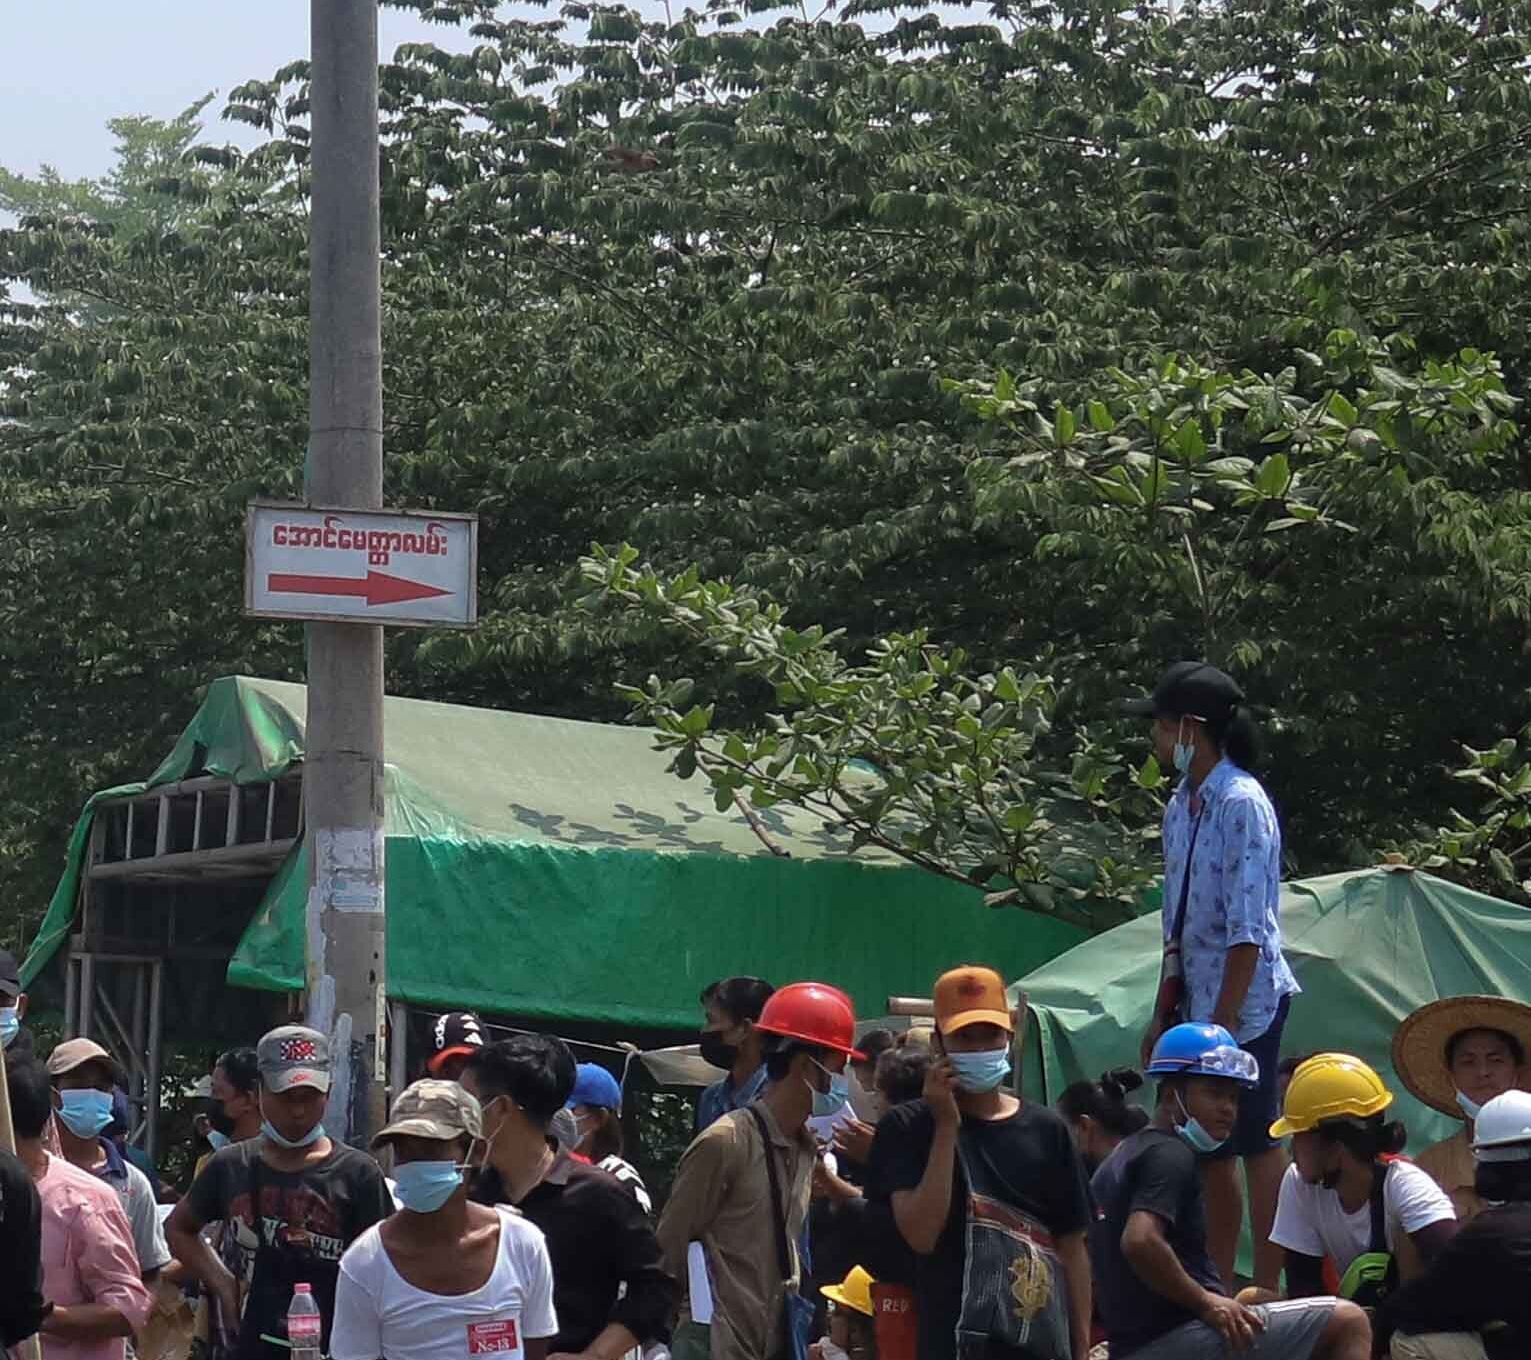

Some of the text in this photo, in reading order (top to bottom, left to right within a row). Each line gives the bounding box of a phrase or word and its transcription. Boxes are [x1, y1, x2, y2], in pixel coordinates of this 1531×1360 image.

[273, 516, 450, 565] အောင်မေတ္တာလမ်း
